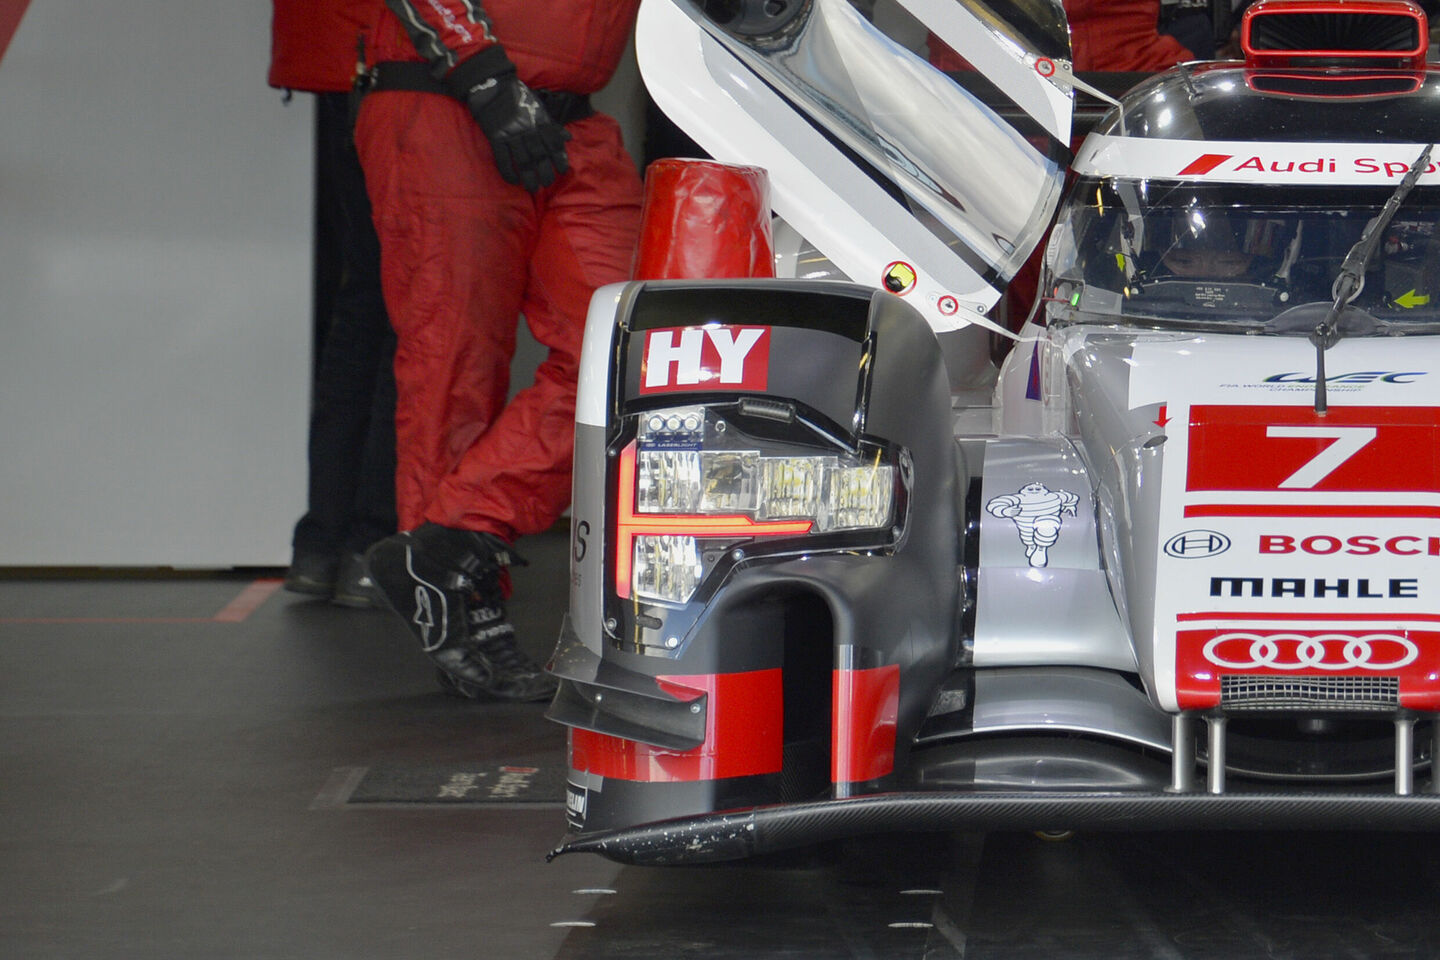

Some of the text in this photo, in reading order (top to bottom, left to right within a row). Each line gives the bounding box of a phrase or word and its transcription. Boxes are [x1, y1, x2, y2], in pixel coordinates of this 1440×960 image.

[1233, 156, 1337, 173] Audi
[645, 328, 766, 388] HY
[1266, 426, 1377, 489] 7
[1210, 577, 1418, 598] MAHLE
